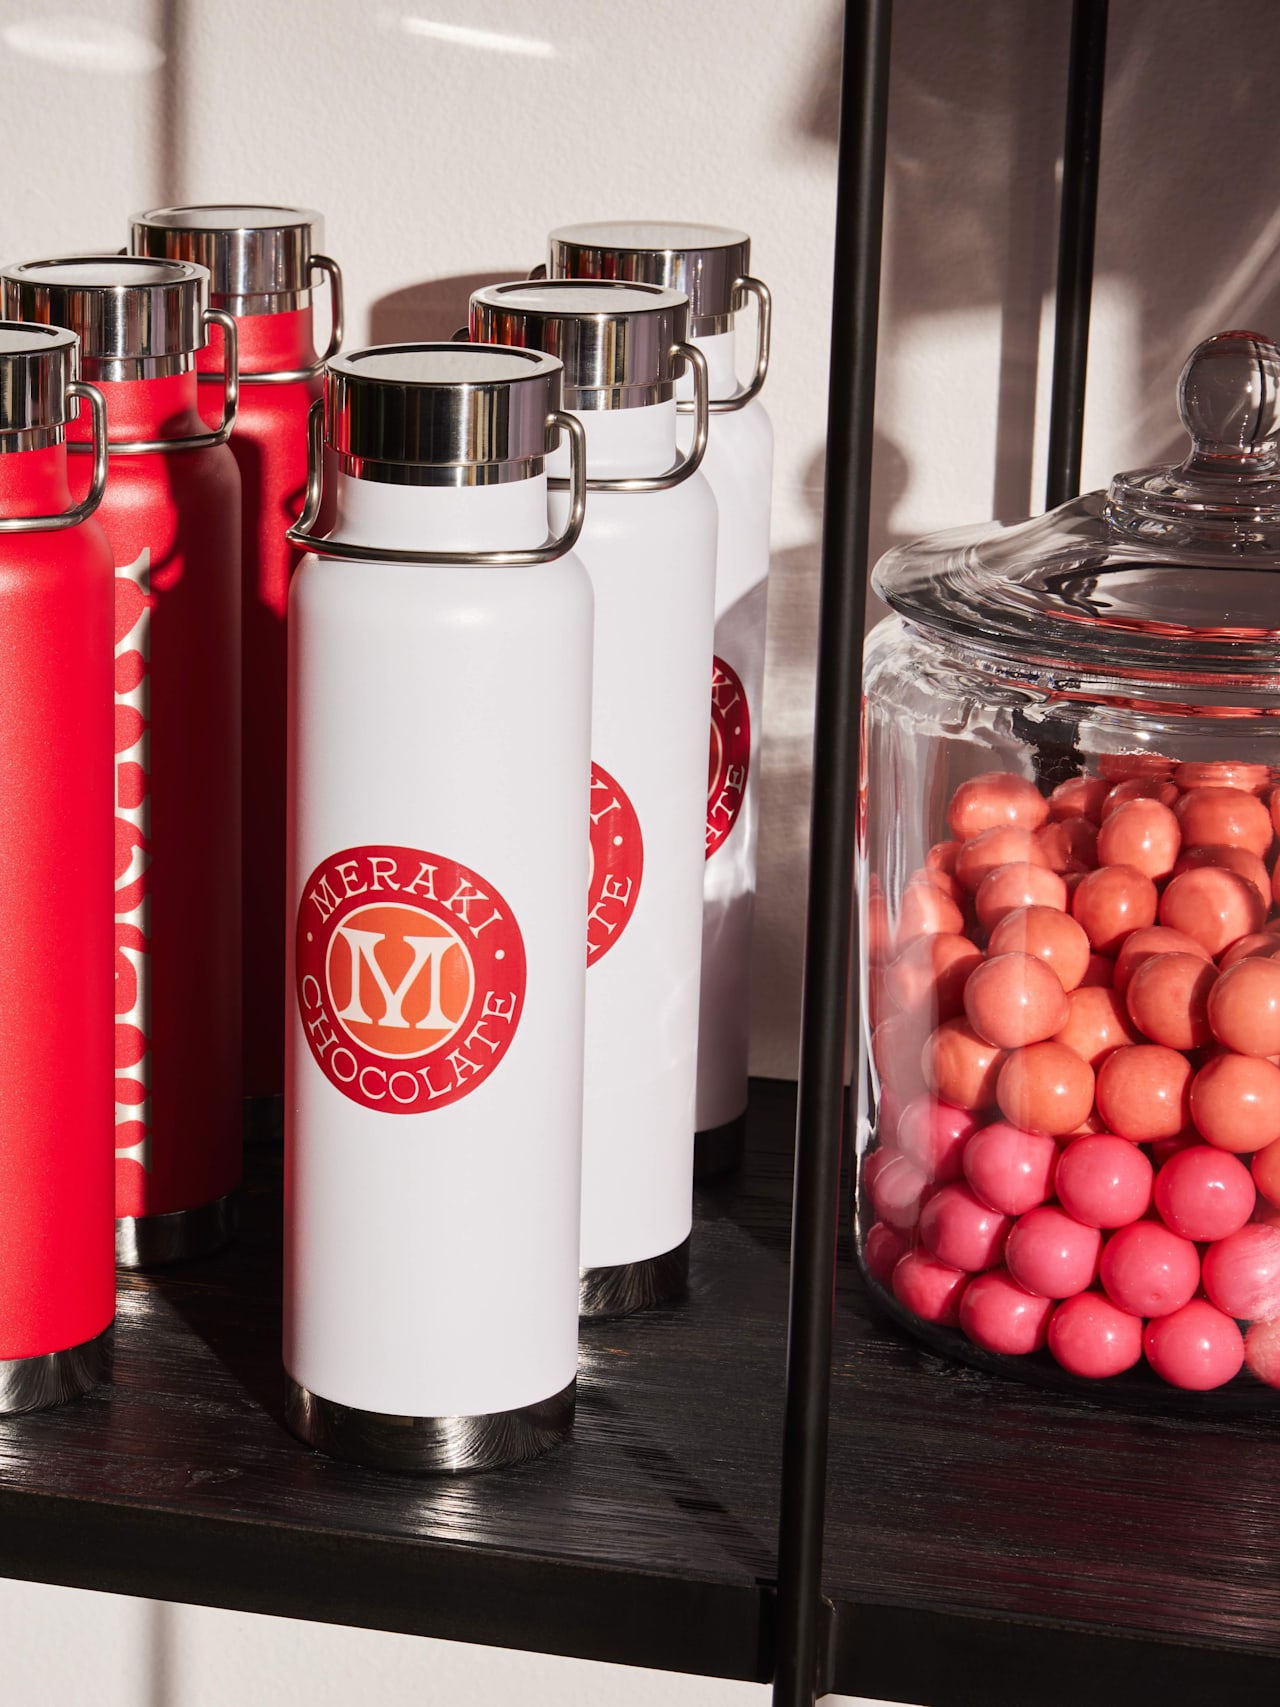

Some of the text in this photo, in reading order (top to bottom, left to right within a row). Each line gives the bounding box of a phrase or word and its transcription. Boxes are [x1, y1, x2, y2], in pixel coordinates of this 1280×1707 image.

[308, 857, 503, 938] MERAKI
[337, 926, 461, 1029] M
[302, 974, 517, 1104] CHOCOLATE
